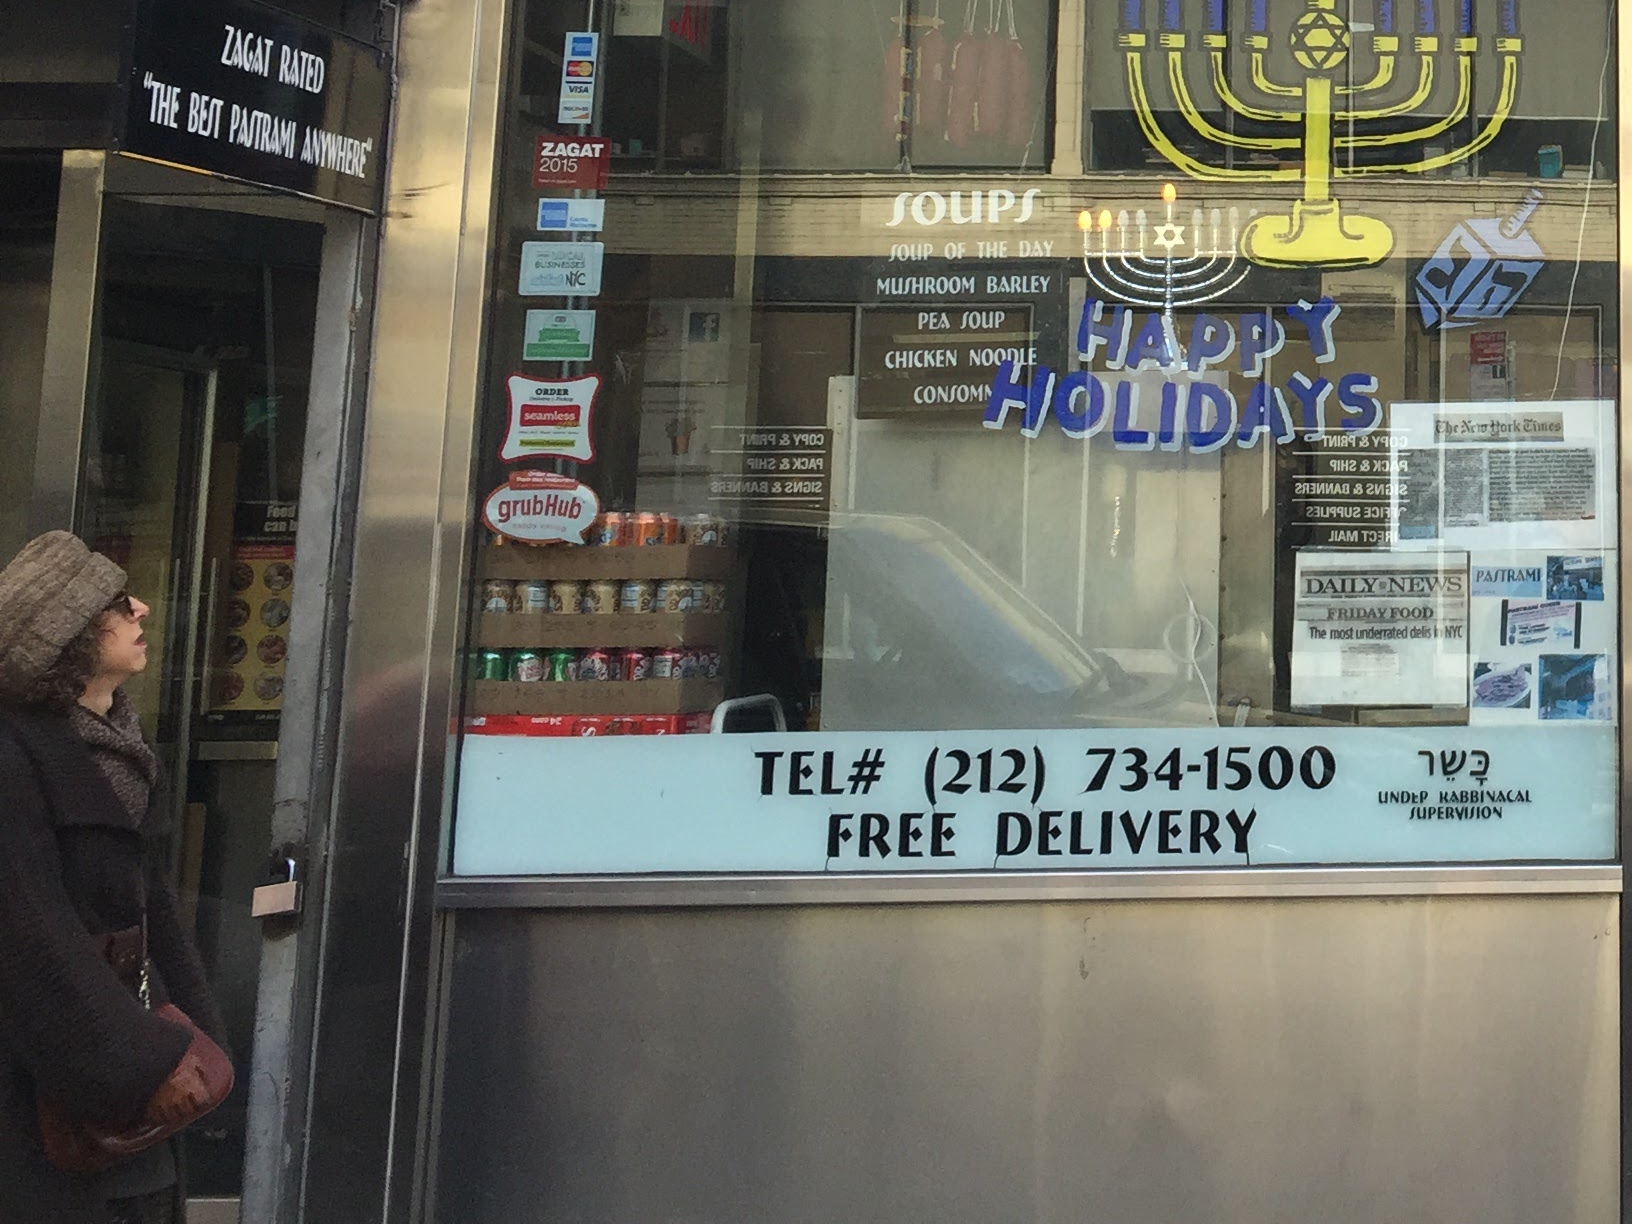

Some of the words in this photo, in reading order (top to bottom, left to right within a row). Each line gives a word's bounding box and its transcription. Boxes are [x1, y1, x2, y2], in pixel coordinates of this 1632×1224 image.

[221, 24, 274, 77] ZAGAT
[279, 44, 325, 94] RATED
[568, 85, 589, 94] VISA
[187, 92, 224, 139] BEST
[229, 103, 297, 159] PASTRAMI
[541, 142, 604, 158] ZAGAT
[539, 158, 578, 173] 2015
[886, 188, 1041, 227] SOUPS
[888, 243, 934, 262] SOUP
[944, 242, 966, 260] OF
[977, 241, 1007, 259] THE
[1019, 240, 1053, 258] DAY
[565, 270, 587, 288] NYC
[876, 276, 975, 295] MUSHROOM
[986, 276, 1051, 294] BARLEY
[918, 311, 950, 330] PEA
[960, 311, 1006, 329] SOUP
[1076, 296, 1342, 378] HAPPY
[885, 349, 958, 369] CHICKEN
[969, 347, 1038, 366] NOODLE
[535, 388, 569, 396] ORDER
[524, 410, 576, 421] seamless
[983, 359, 1383, 454] HOLIDAYS
[1435, 419, 1459, 434] The
[1461, 419, 1487, 434] New
[1490, 419, 1521, 437] York
[1523, 418, 1562, 433] Times
[498, 494, 582, 524] grubHub
[1476, 567, 1542, 583] PASTRAMI
[1306, 577, 1379, 594] DAILY
[1388, 576, 1463, 593] NEWS
[1326, 607, 1387, 619] FRIDAY
[1390, 606, 1435, 619] FOOD
[1310, 626, 1327, 639] The
[1330, 626, 1354, 640] most
[1356, 626, 1408, 640] underrated
[1445, 625, 1463, 638] NYC
[755, 748, 886, 795] TEL#
[925, 746, 1047, 796] (212)
[1083, 747, 1337, 792] 734-1500
[1409, 805, 1503, 821] SUPERVISION
[826, 812, 957, 857] FREE
[996, 811, 1258, 857] DELIVERY
